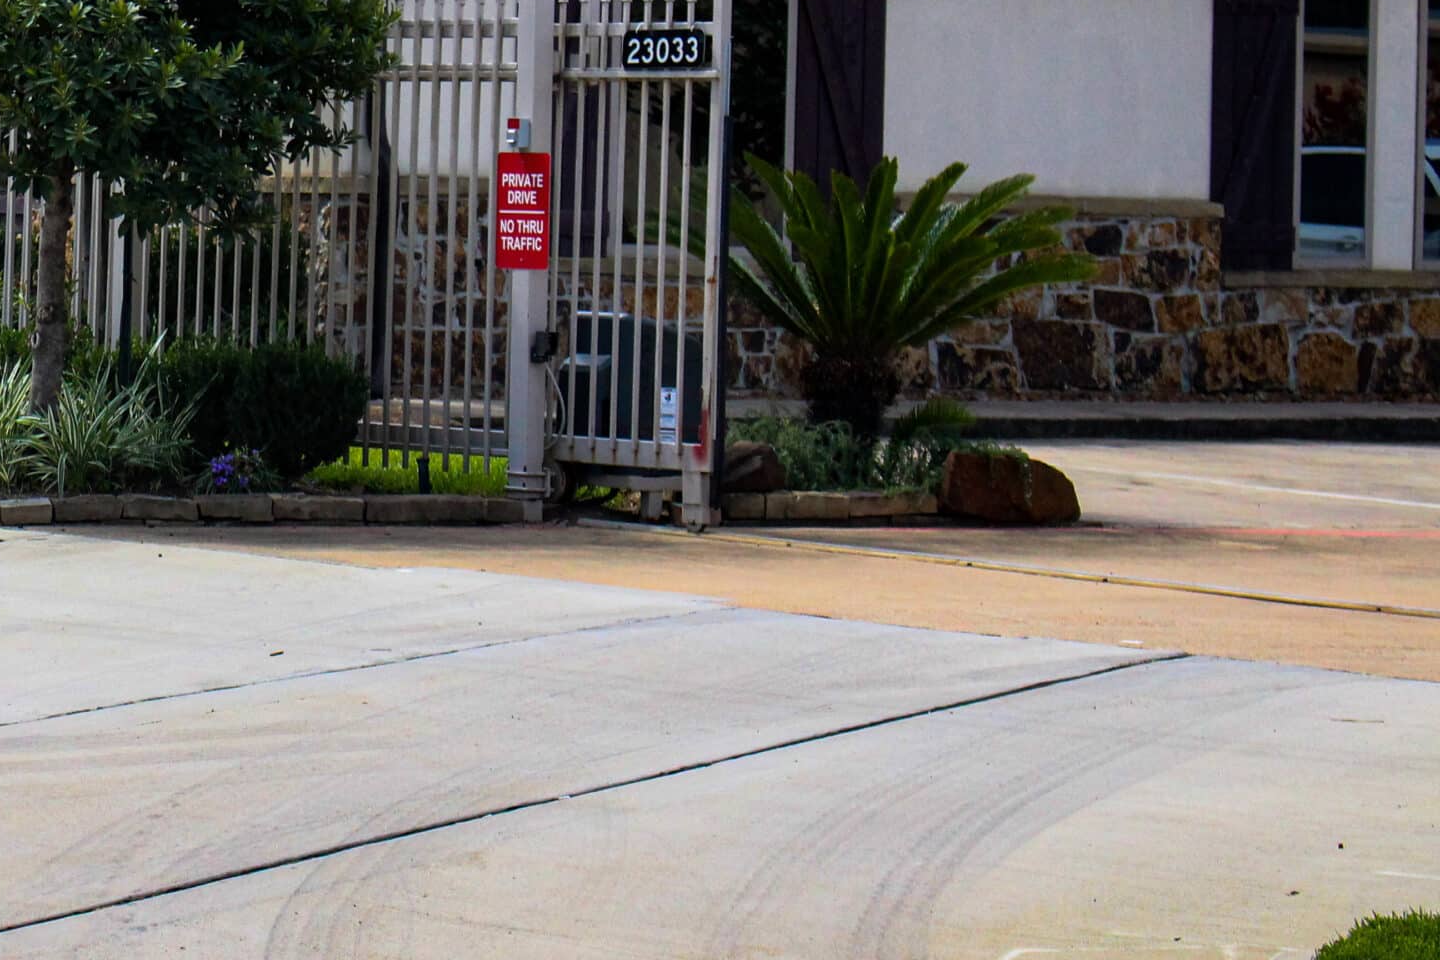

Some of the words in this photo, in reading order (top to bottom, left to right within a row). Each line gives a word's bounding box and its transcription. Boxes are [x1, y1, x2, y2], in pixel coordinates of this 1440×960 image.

[627, 36, 698, 64] 23033
[501, 172, 544, 188] PRIVATE
[507, 190, 537, 205] DRIVE
[500, 219, 514, 233] NO
[517, 219, 544, 234] THRU
[501, 236, 542, 251] TRAFFIC
